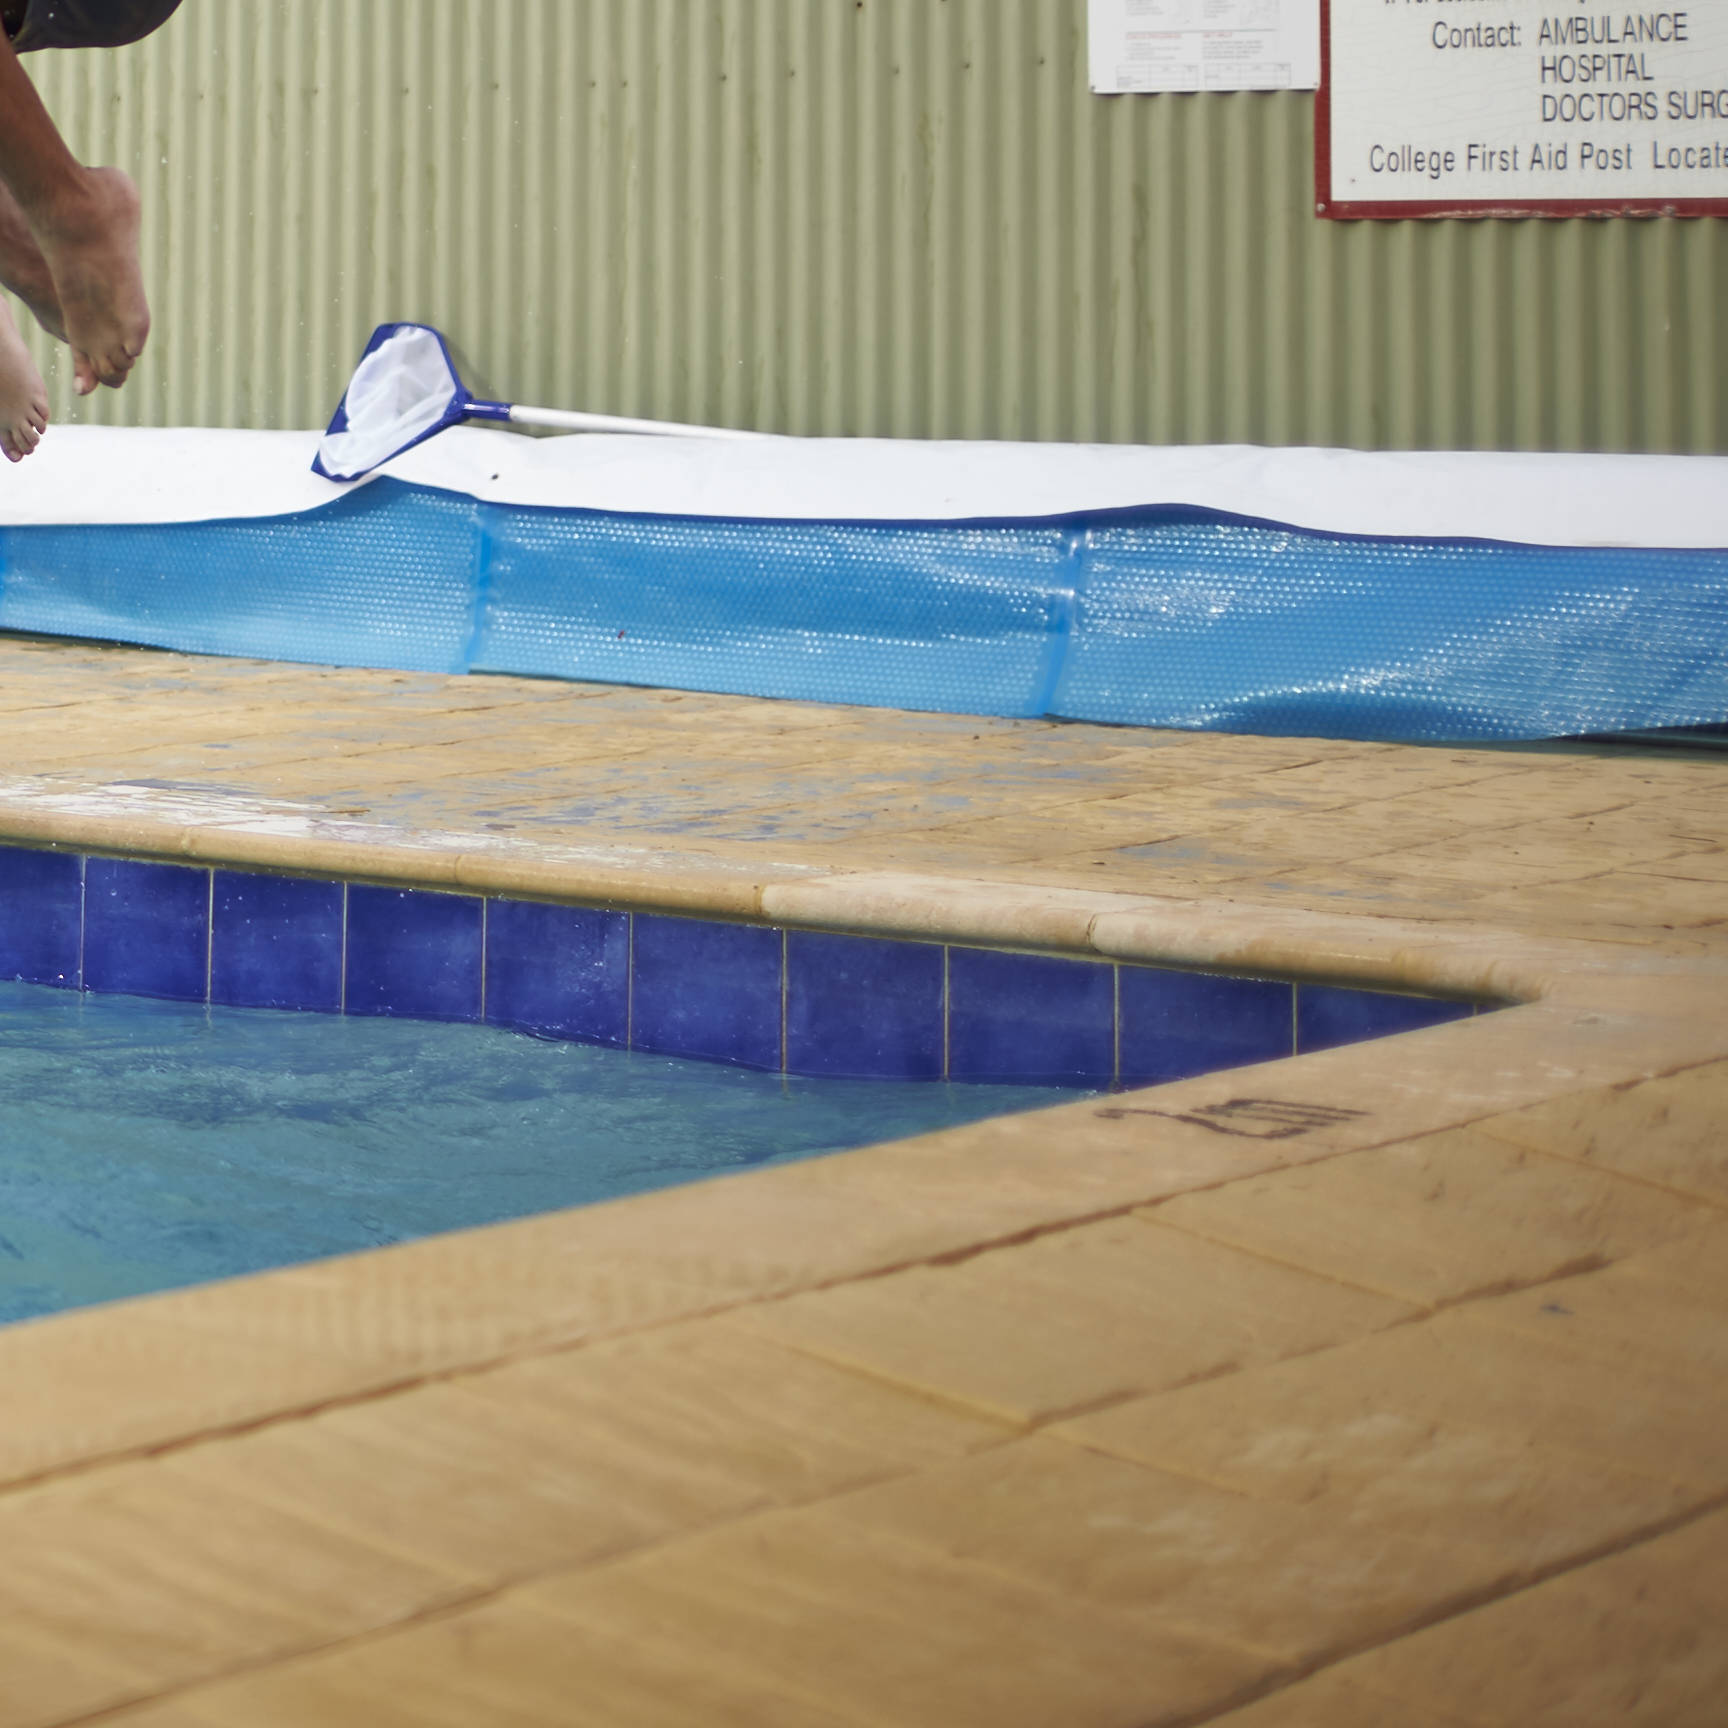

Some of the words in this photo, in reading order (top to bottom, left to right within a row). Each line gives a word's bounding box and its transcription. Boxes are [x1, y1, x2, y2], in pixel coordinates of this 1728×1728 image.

[1432, 21, 1522, 49] Contact:
[1539, 12, 1688, 45] AMBULANCE
[1541, 52, 1654, 83] HOSPITAL
[1543, 90, 1658, 123] DOCTORS
[1370, 143, 1455, 179] College
[1468, 143, 1519, 171] First
[1530, 141, 1568, 171] Aid
[1580, 141, 1632, 171] Post
